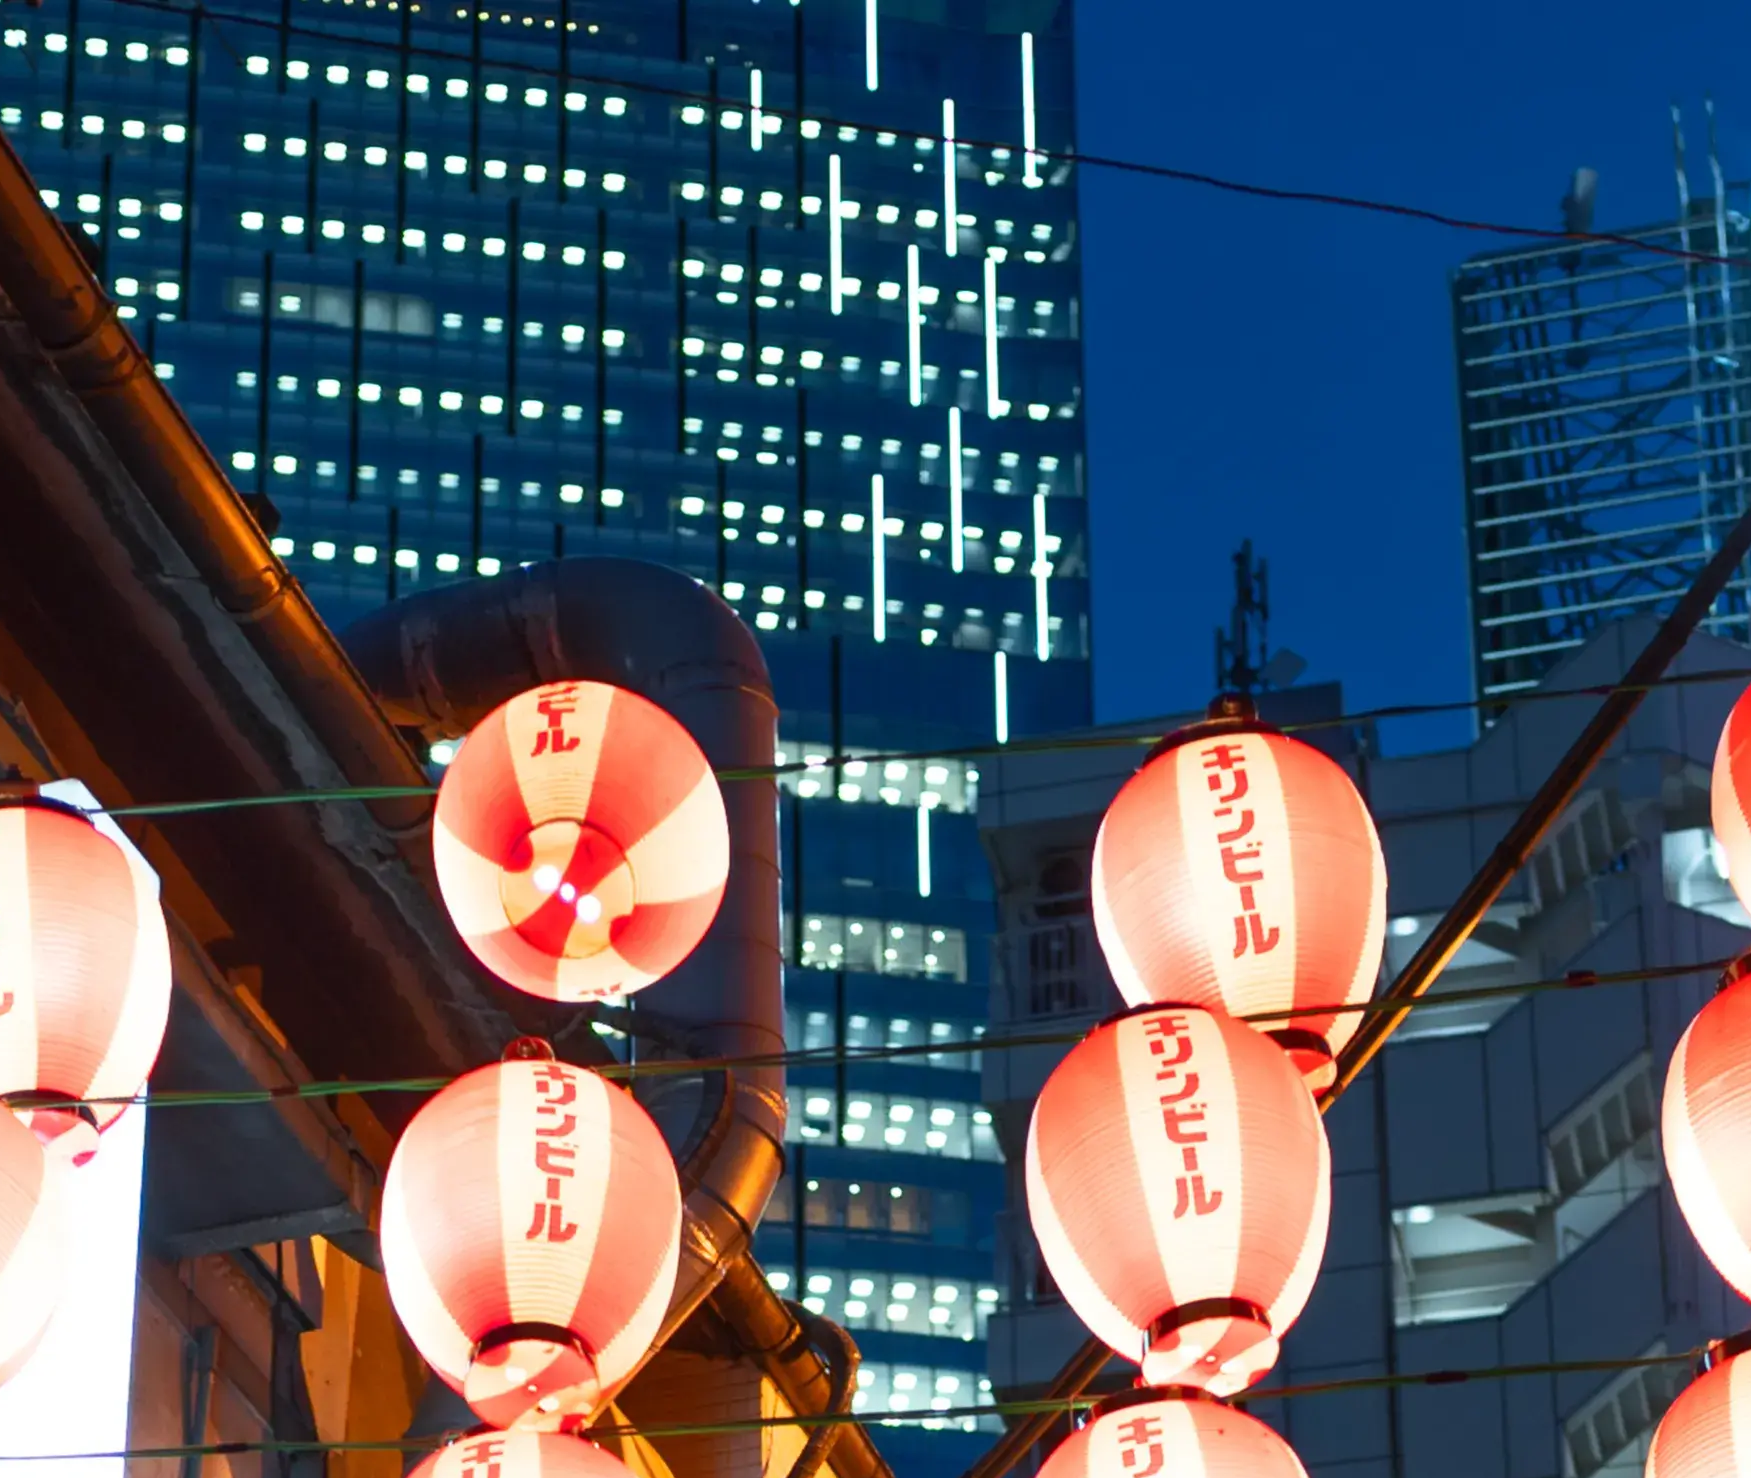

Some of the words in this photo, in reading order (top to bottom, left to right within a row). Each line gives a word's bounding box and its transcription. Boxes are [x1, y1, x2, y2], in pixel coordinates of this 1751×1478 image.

[1200, 742, 1281, 960] キリンビール
[1141, 1014, 1223, 1221] キリンビール
